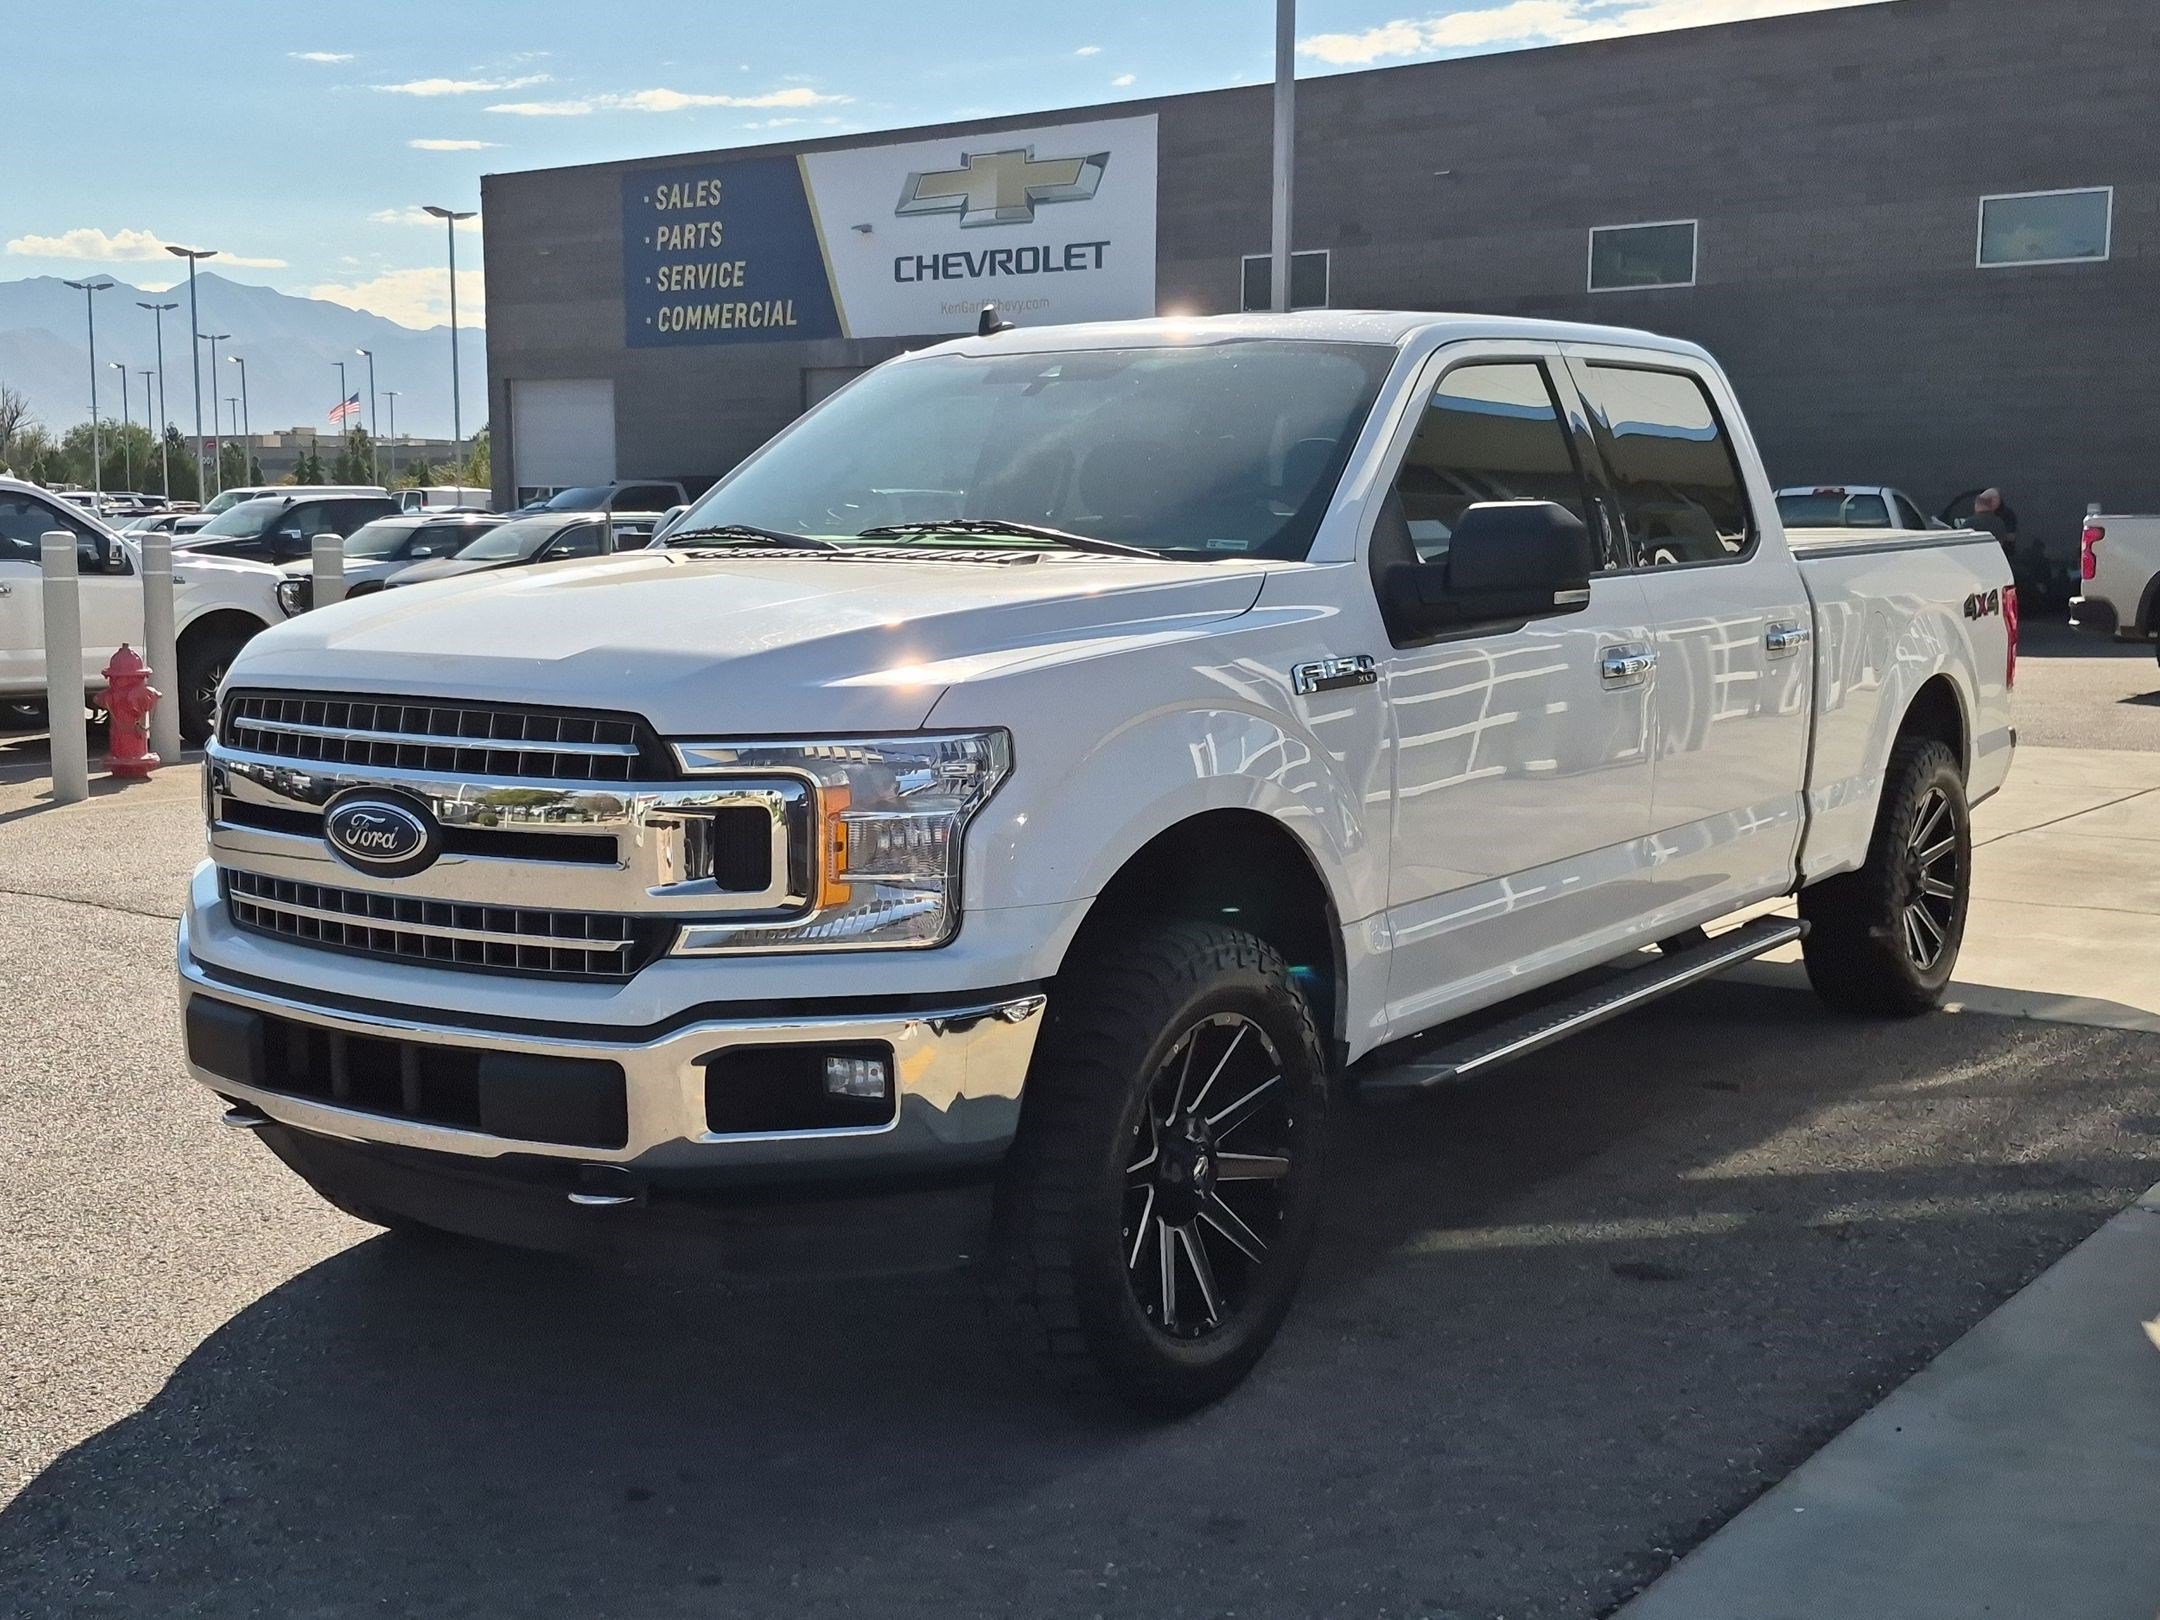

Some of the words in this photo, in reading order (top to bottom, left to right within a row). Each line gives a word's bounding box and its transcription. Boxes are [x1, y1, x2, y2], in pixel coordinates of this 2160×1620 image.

[655, 179, 722, 211] SALES
[656, 221, 723, 251] PARTS
[657, 261, 746, 292] SERVICE
[894, 240, 1111, 282] CHEVROLET
[658, 300, 797, 332] COMMERCIAL
[345, 813, 400, 850] Ford
